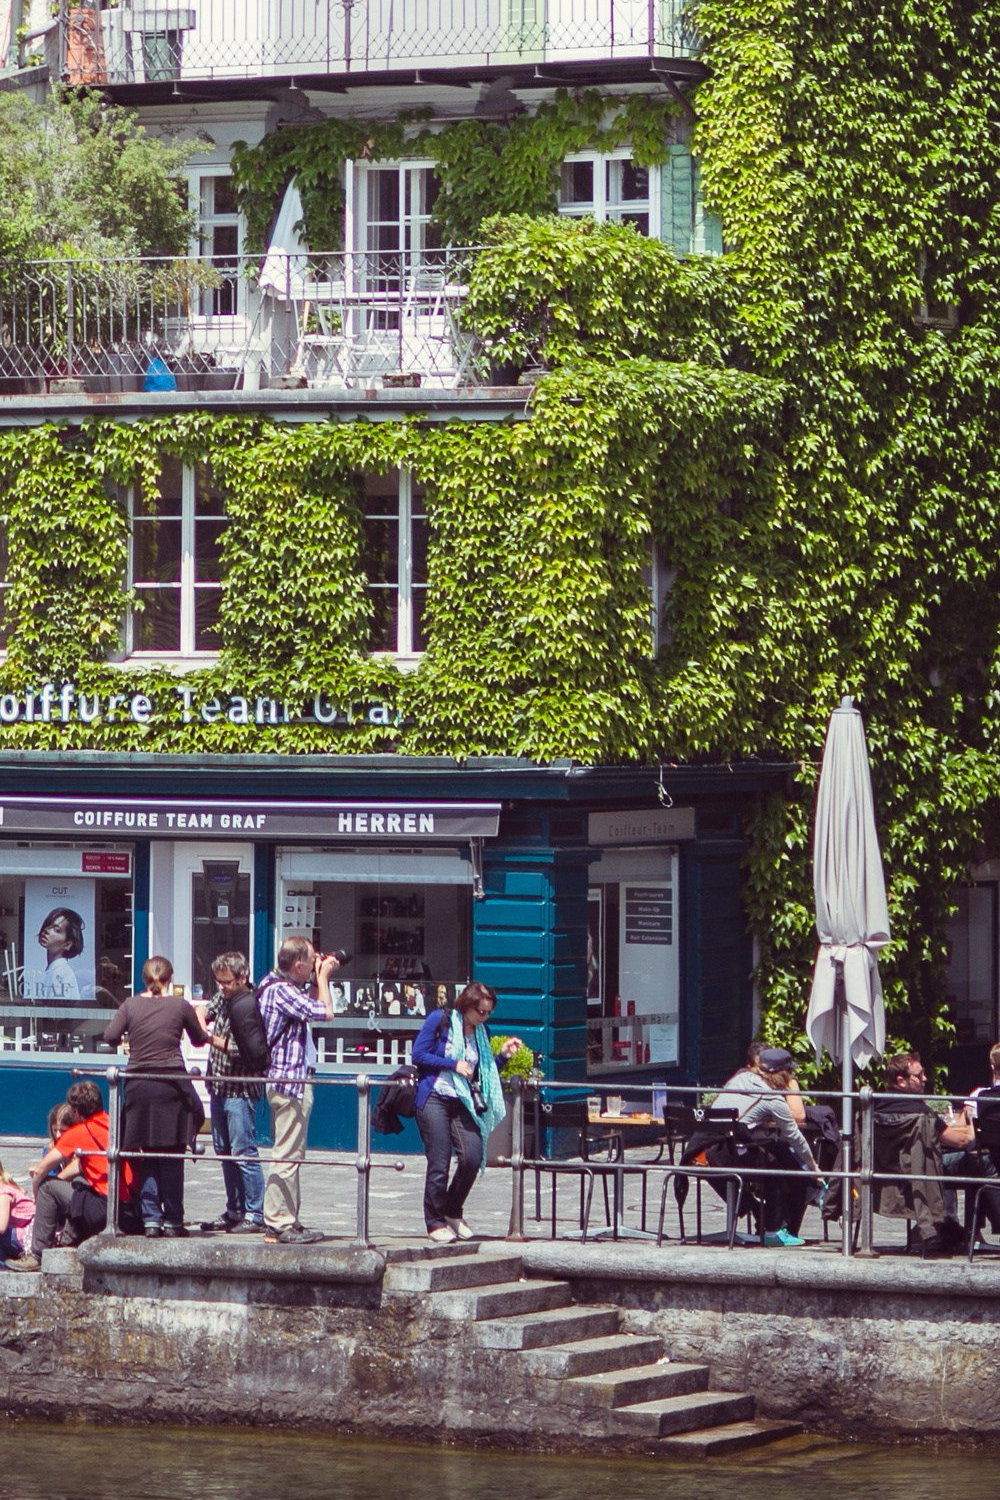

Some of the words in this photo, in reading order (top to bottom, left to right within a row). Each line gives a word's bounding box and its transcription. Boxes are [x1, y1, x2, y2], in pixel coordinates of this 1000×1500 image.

[73, 811, 159, 828] COIFFURE
[166, 813, 213, 828] TEAM
[220, 814, 266, 829] GRAF
[338, 812, 435, 833] HERREN
[52, 886, 69, 895] CUT
[19, 982, 71, 998] GRAF
